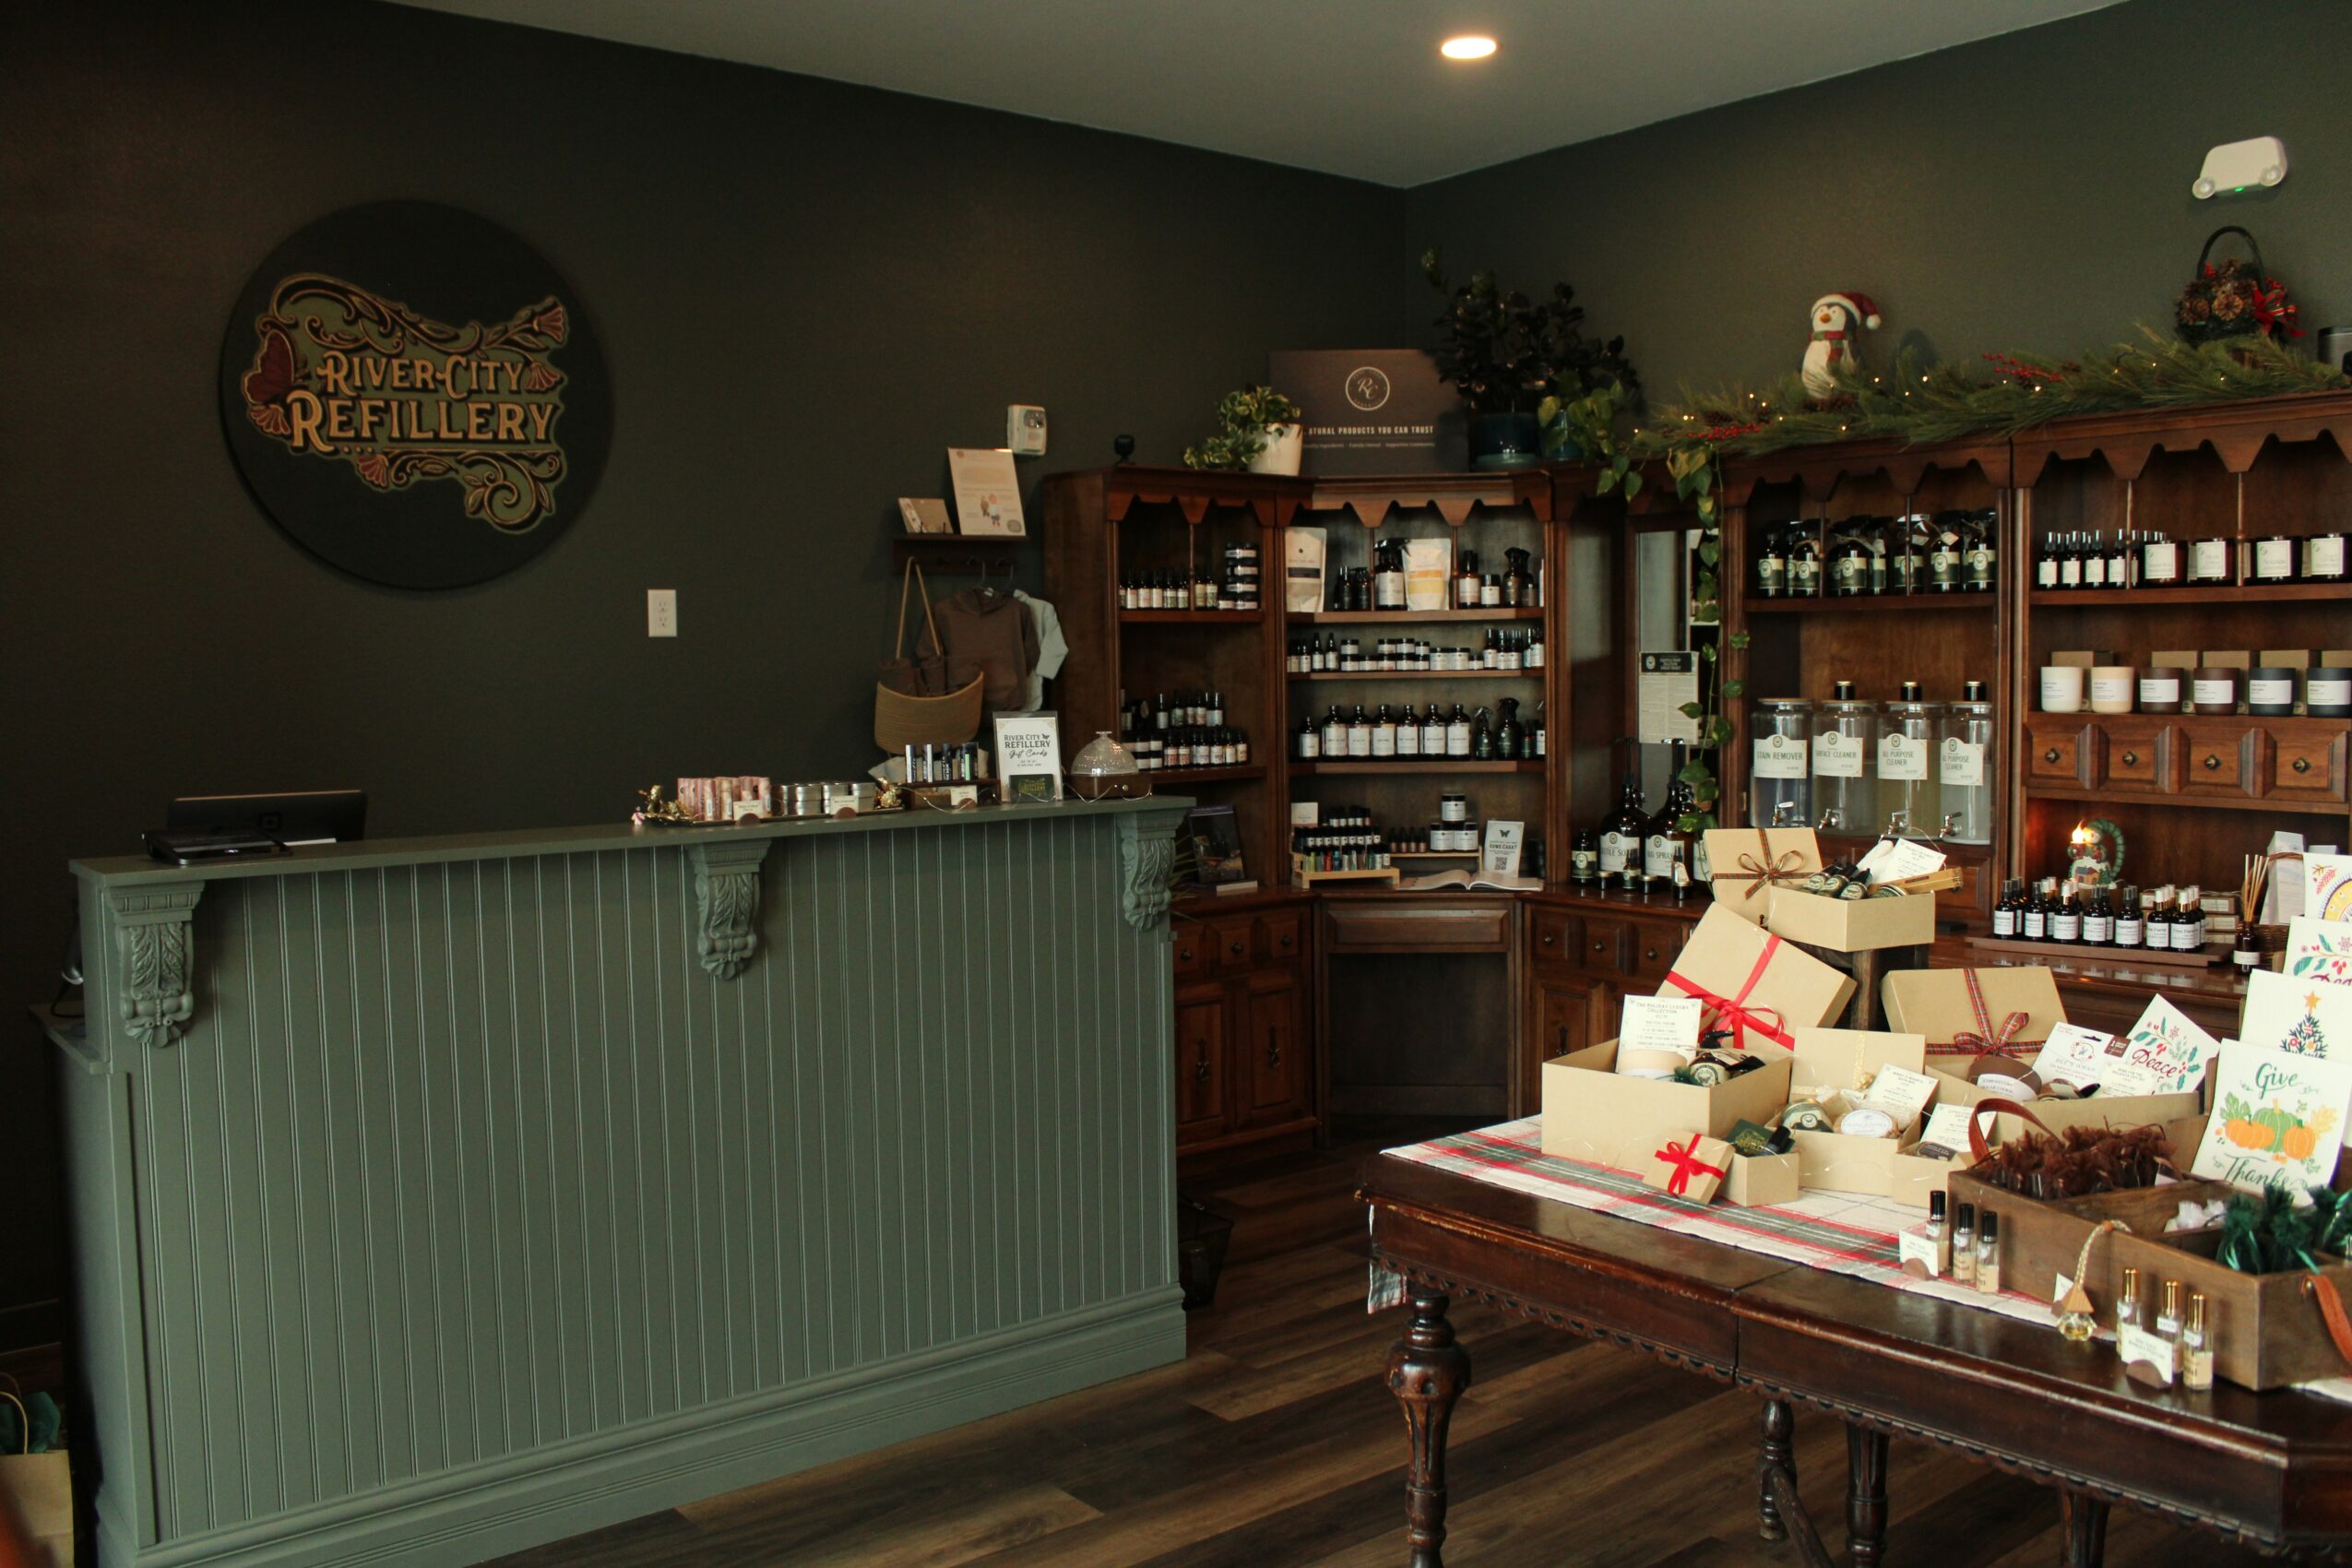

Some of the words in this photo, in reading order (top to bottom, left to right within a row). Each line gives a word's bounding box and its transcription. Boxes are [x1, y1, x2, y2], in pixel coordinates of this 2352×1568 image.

[316, 350, 437, 398] RIVER
[436, 353, 523, 399] CITY
[286, 389, 553, 452] REFILLERY
[1304, 426, 1336, 435] ATURAL
[1338, 426, 1375, 434] PRODUCTS
[1378, 426, 1392, 434] YOU
[1394, 426, 1408, 434] CAN
[1411, 425, 1433, 434] TRUST
[1004, 740, 1051, 749] REFILLERY
[1009, 749, 1025, 759] Gift
[1026, 748, 1048, 757] Cards
[1756, 752, 1771, 760] STAIN
[1772, 752, 1803, 761] REMOVER
[1833, 751, 1858, 759] CLEANER
[1886, 758, 1907, 766] CLEANER
[1947, 754, 1969, 764] PURPOSE
[2131, 1048, 2178, 1078] Peace
[2255, 1063, 2300, 1099] Give
[2223, 1154, 2290, 1187] Thanks
